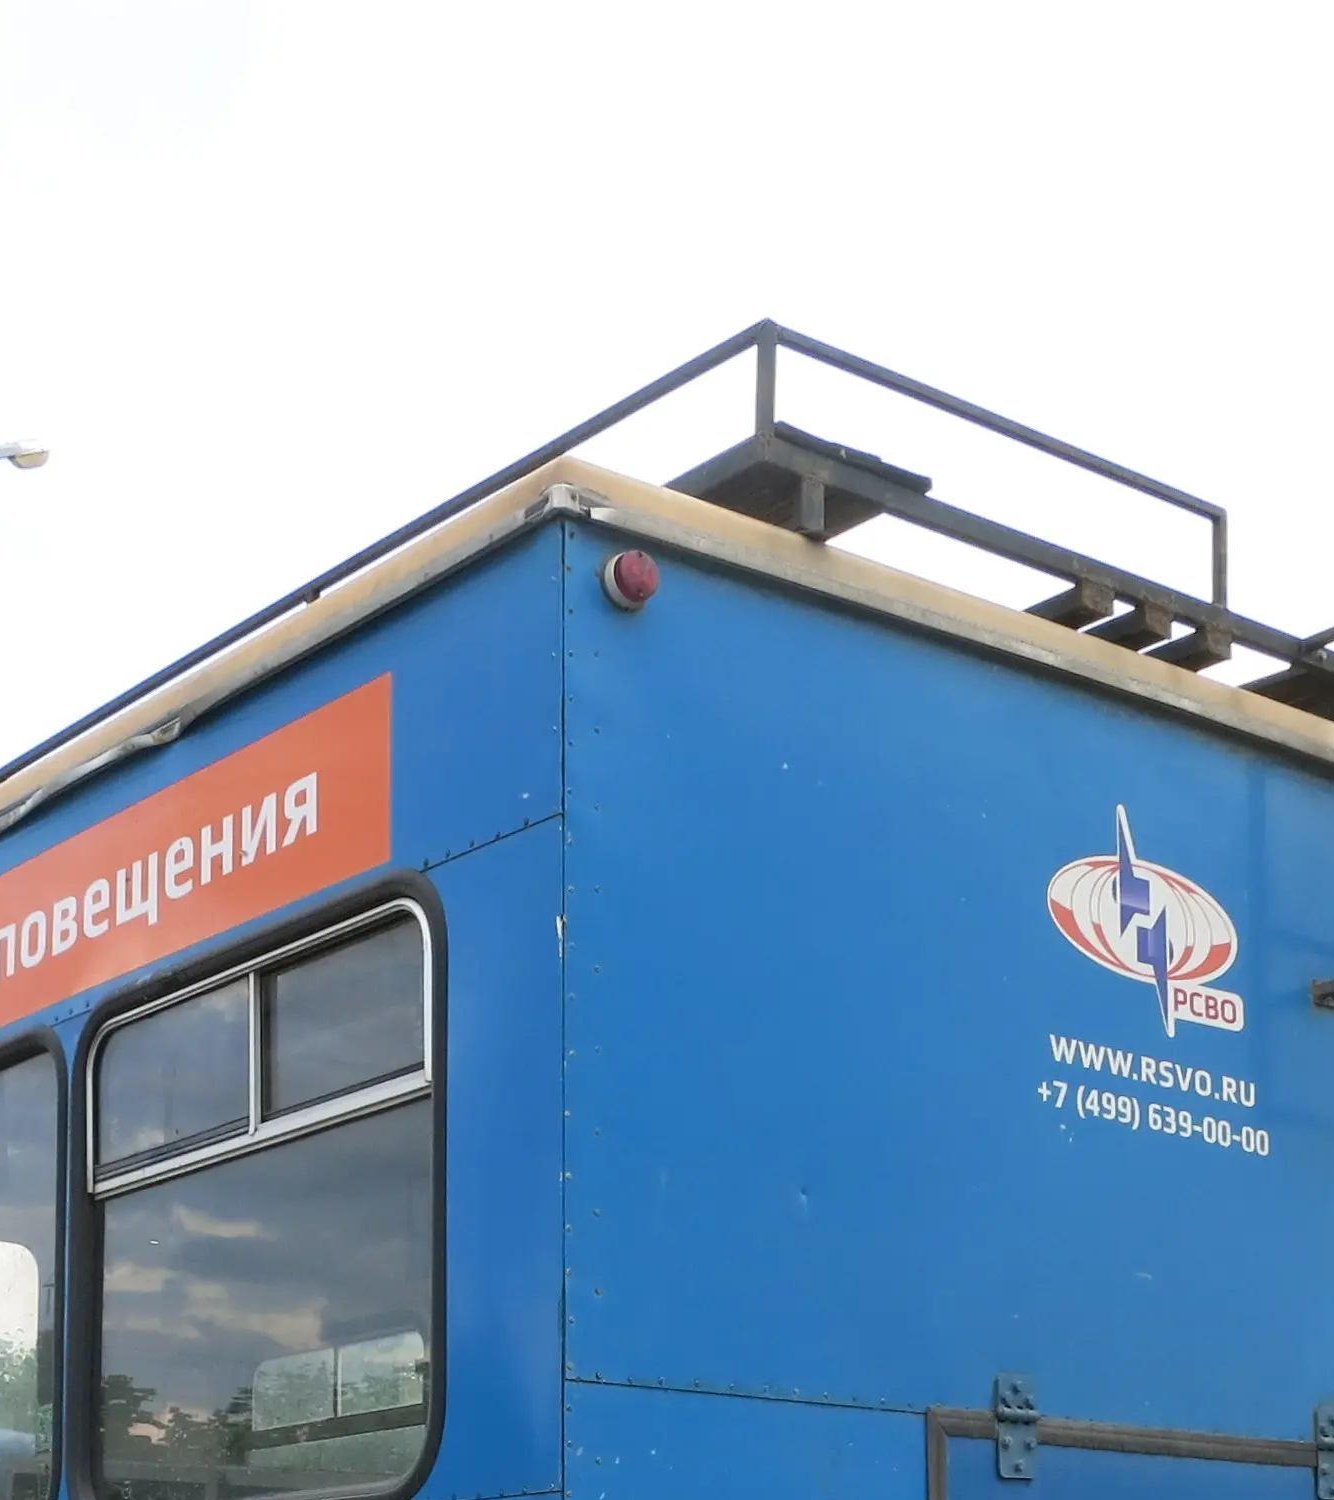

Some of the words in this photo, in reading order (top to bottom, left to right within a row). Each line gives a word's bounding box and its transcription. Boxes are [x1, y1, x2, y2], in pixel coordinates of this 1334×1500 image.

[1049, 1033, 1256, 1108] WWW.RSVO.RU
[1037, 1080, 1068, 1109] +7
[1076, 1085, 1141, 1130] (499)
[1148, 1103, 1270, 1157] 639-00-00
